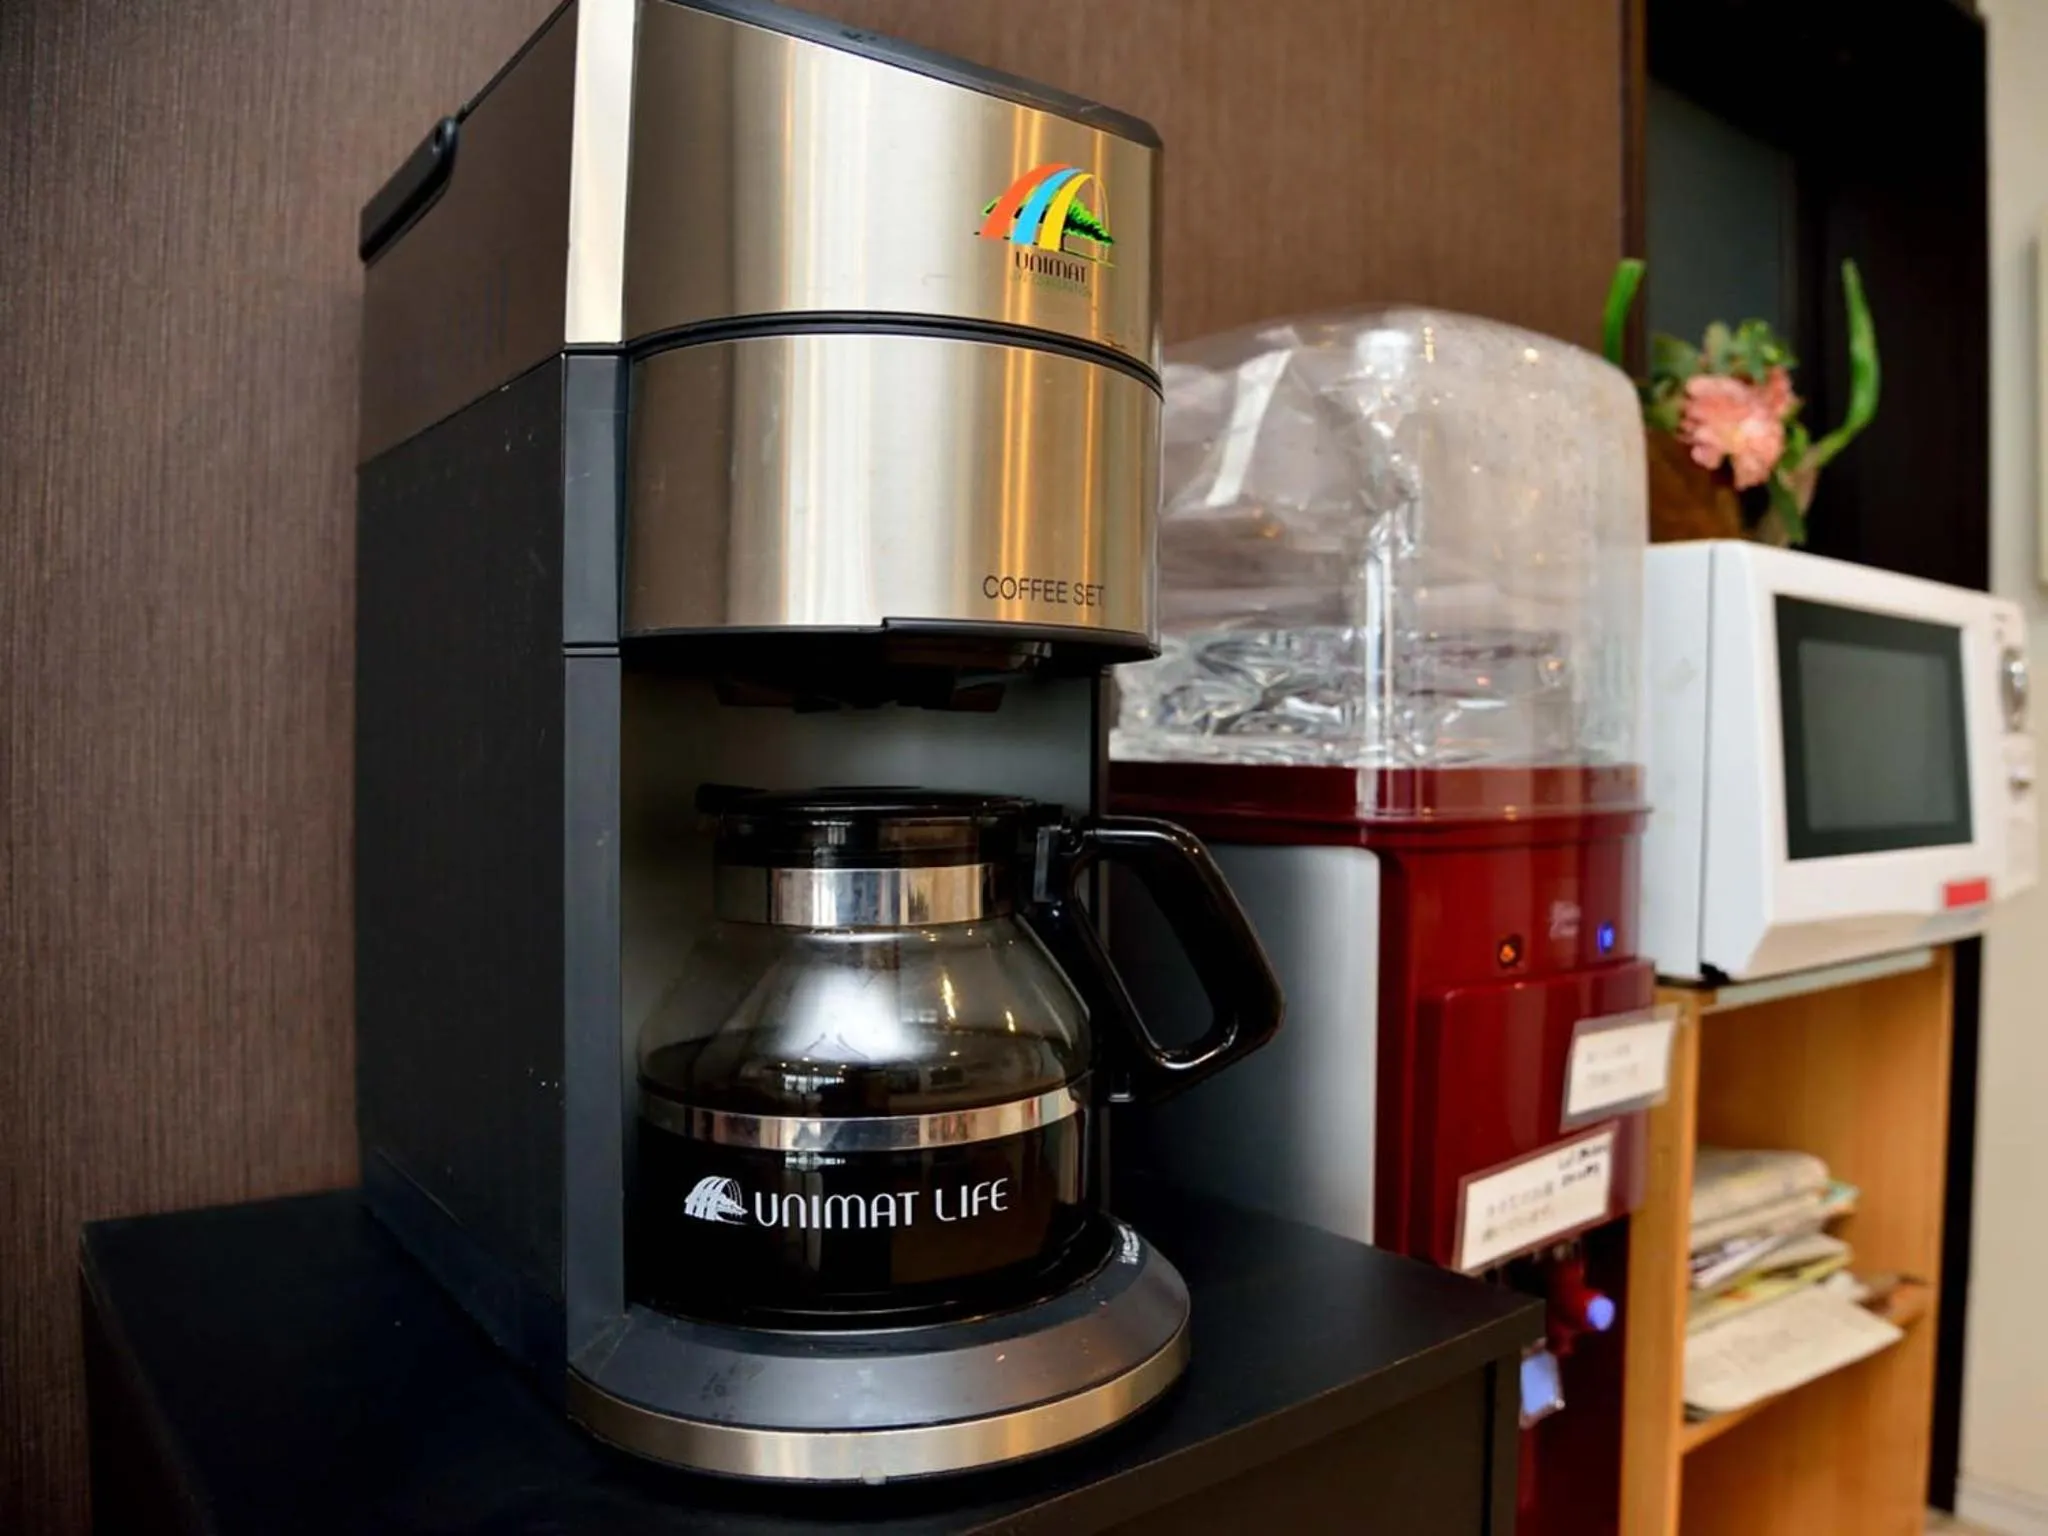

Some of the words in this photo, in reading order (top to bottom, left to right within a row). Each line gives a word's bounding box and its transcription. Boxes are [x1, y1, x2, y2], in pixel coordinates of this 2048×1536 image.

[1015, 251, 1087, 283] UNIMAT
[983, 575, 1068, 603] COFFEE
[1073, 582, 1105, 606] SET
[755, 1191, 919, 1228] UNIMAT
[935, 1178, 1008, 1221] LIFE
